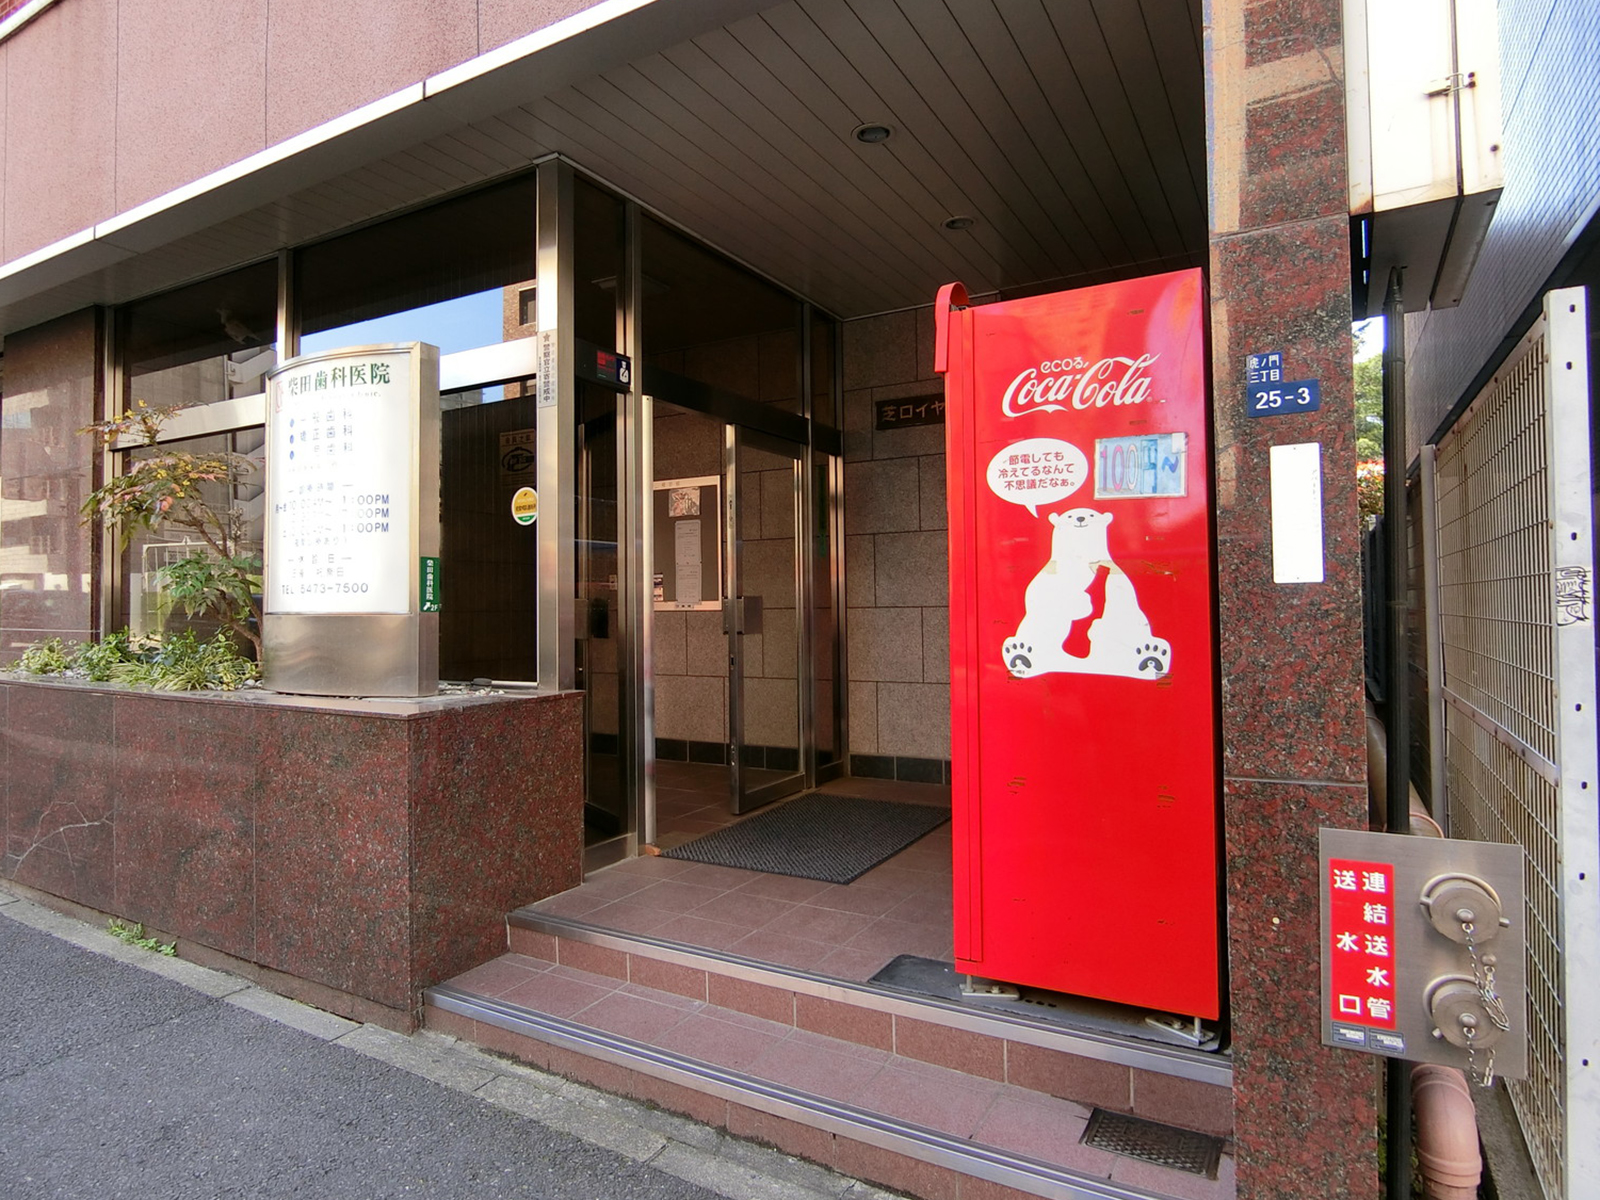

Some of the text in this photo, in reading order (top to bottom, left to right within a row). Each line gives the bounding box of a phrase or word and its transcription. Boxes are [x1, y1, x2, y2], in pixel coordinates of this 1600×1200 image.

[1249, 354, 1280, 369] 虎ノ門
[288, 362, 391, 396] 柴田歯科医院
[1250, 369, 1280, 384] 三丁目
[1002, 353, 1162, 418] Coca-Cola
[1255, 387, 1311, 410] 25-3
[1008, 451, 1065, 466] 節電しても
[998, 462, 1075, 479] 冷えてるなんて
[1004, 475, 1076, 491] 不思議だなぁ。
[300, 582, 369, 595] 5473-7500
[1333, 869, 1362, 1015] 送水口
[1362, 871, 1391, 1020] 連結送水管
